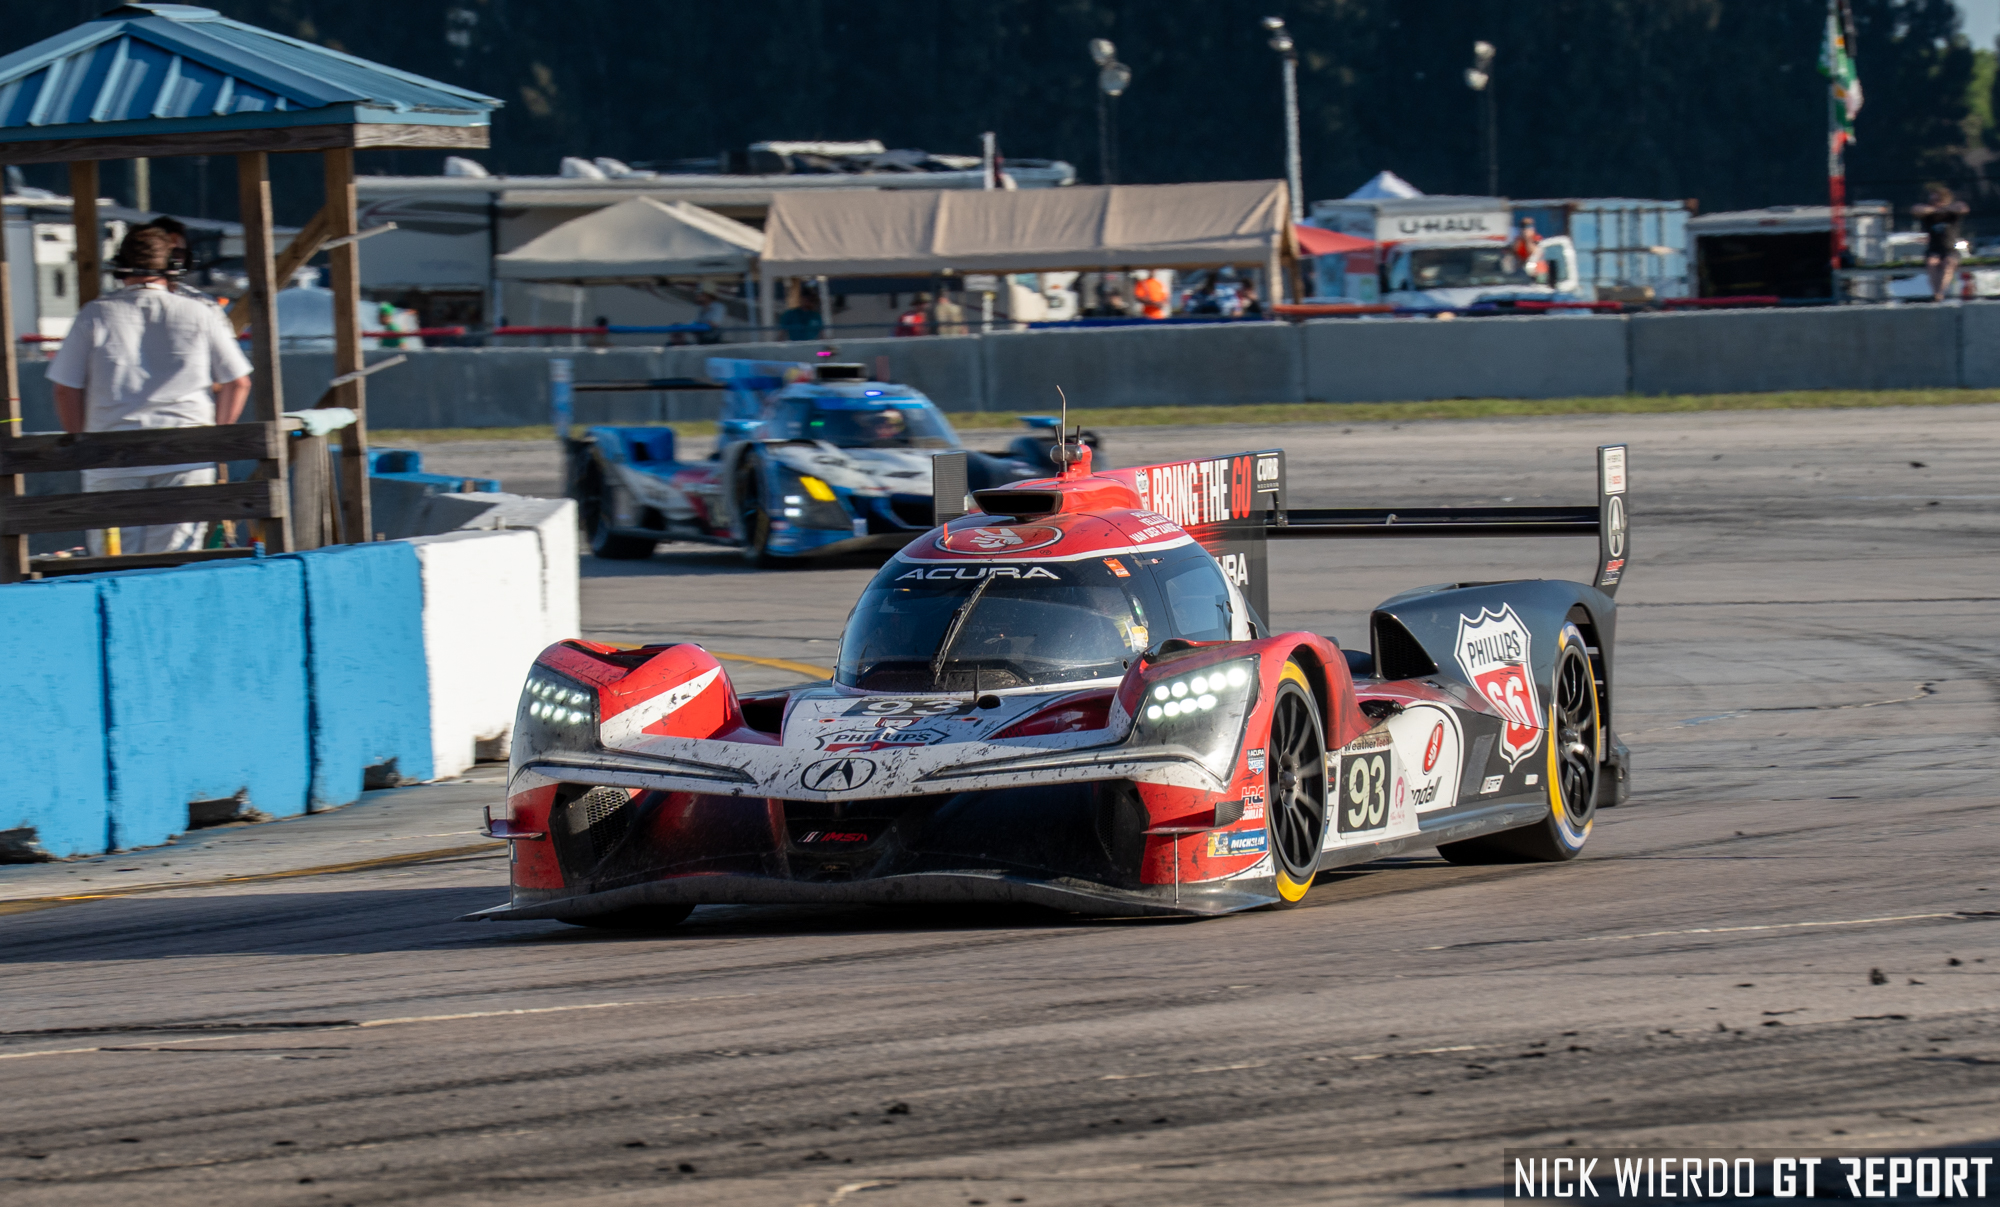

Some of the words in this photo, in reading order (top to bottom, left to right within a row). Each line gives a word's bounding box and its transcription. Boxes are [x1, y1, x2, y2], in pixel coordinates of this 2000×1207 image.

[1398, 217, 1488, 233] U-HAUL
[1257, 457, 1279, 481] CURB
[1152, 462, 1199, 526] BRING
[1200, 459, 1230, 523] THE
[1231, 455, 1252, 520] GO
[1128, 530, 1150, 543] VAN
[894, 566, 1062, 581] ACURA
[1467, 630, 1522, 668] PHILLIPS
[861, 700, 964, 716] 93
[1486, 676, 1532, 731] 66
[833, 733, 932, 743] PHILLIPS
[1348, 755, 1387, 829] 93
[1411, 776, 1443, 806] ndall
[820, 832, 869, 842] IMSA
[1230, 836, 1266, 849] MICHELIN
